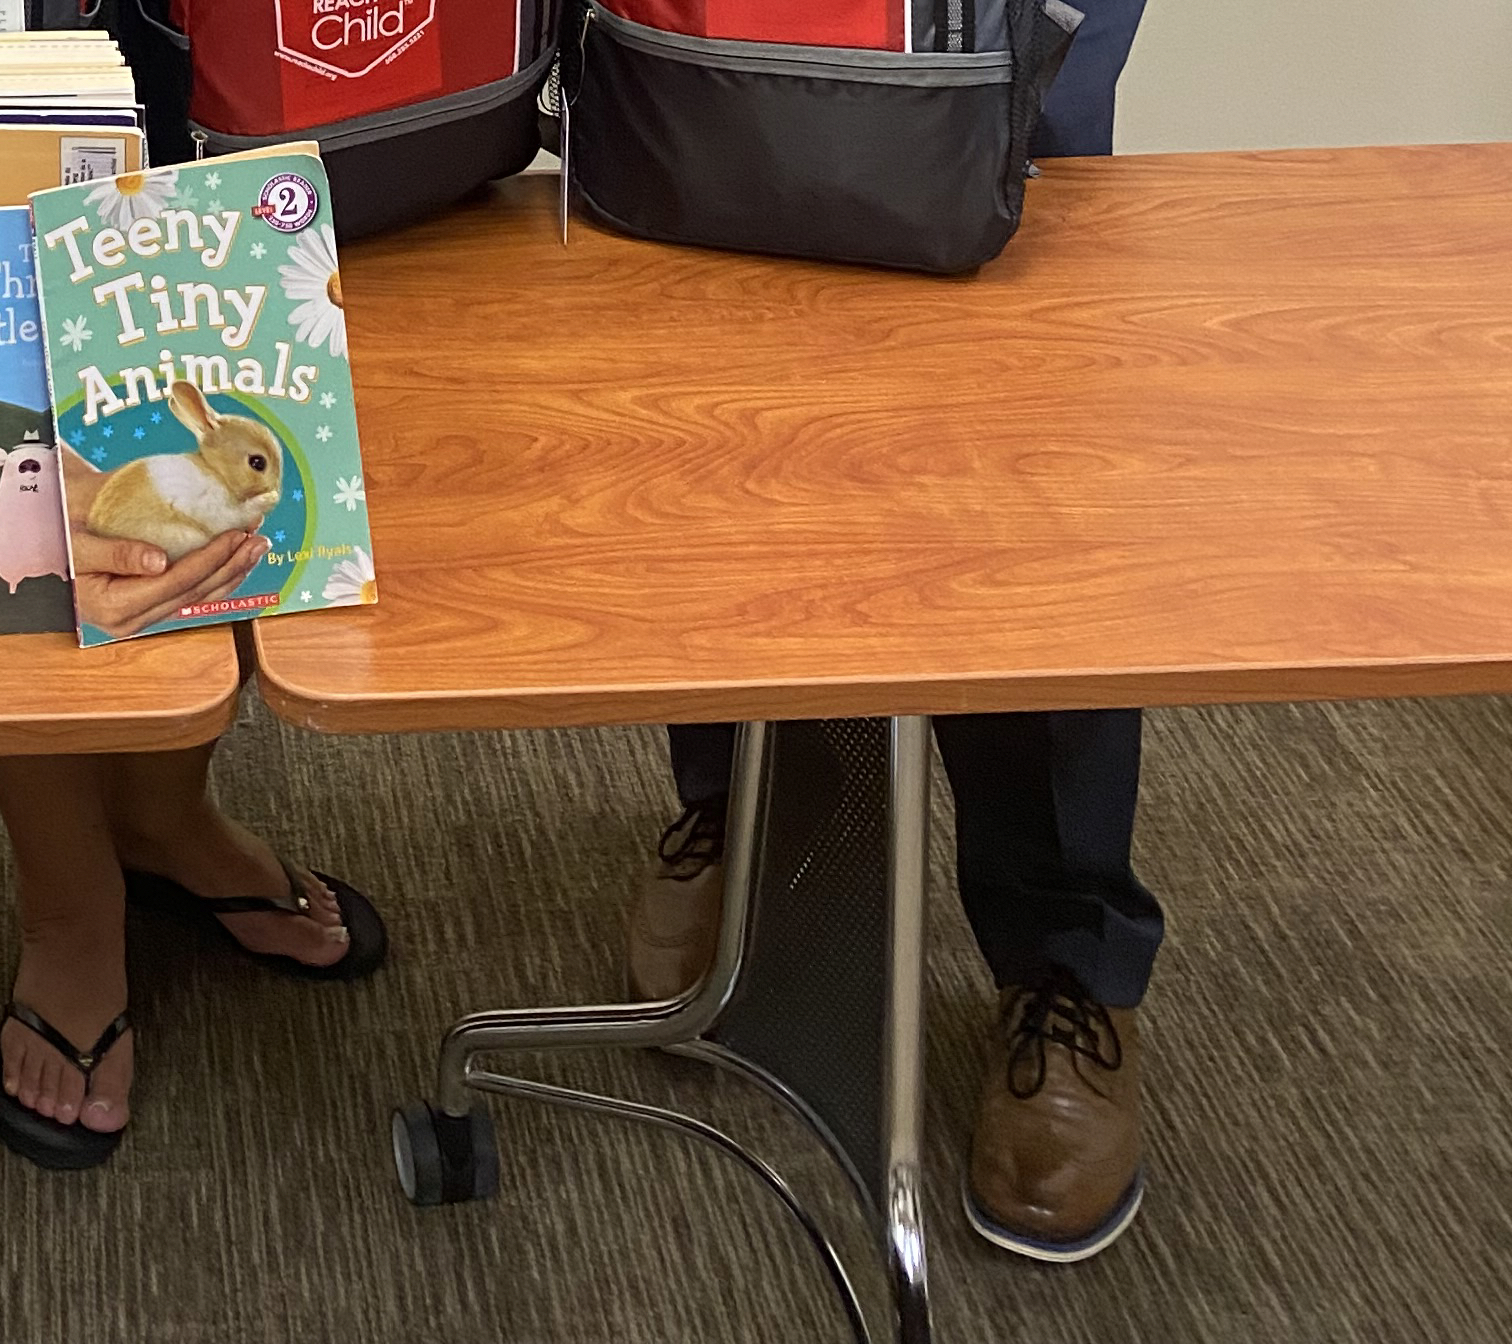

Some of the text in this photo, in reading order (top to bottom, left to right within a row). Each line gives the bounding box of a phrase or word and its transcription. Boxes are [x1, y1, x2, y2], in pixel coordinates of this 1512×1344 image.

[279, 187, 298, 217] 2
[44, 208, 242, 284] Teeny
[92, 271, 269, 349] Tiny
[78, 340, 320, 426] Animals
[267, 551, 284, 567] By
[193, 595, 279, 615] SCHOLASTIC
